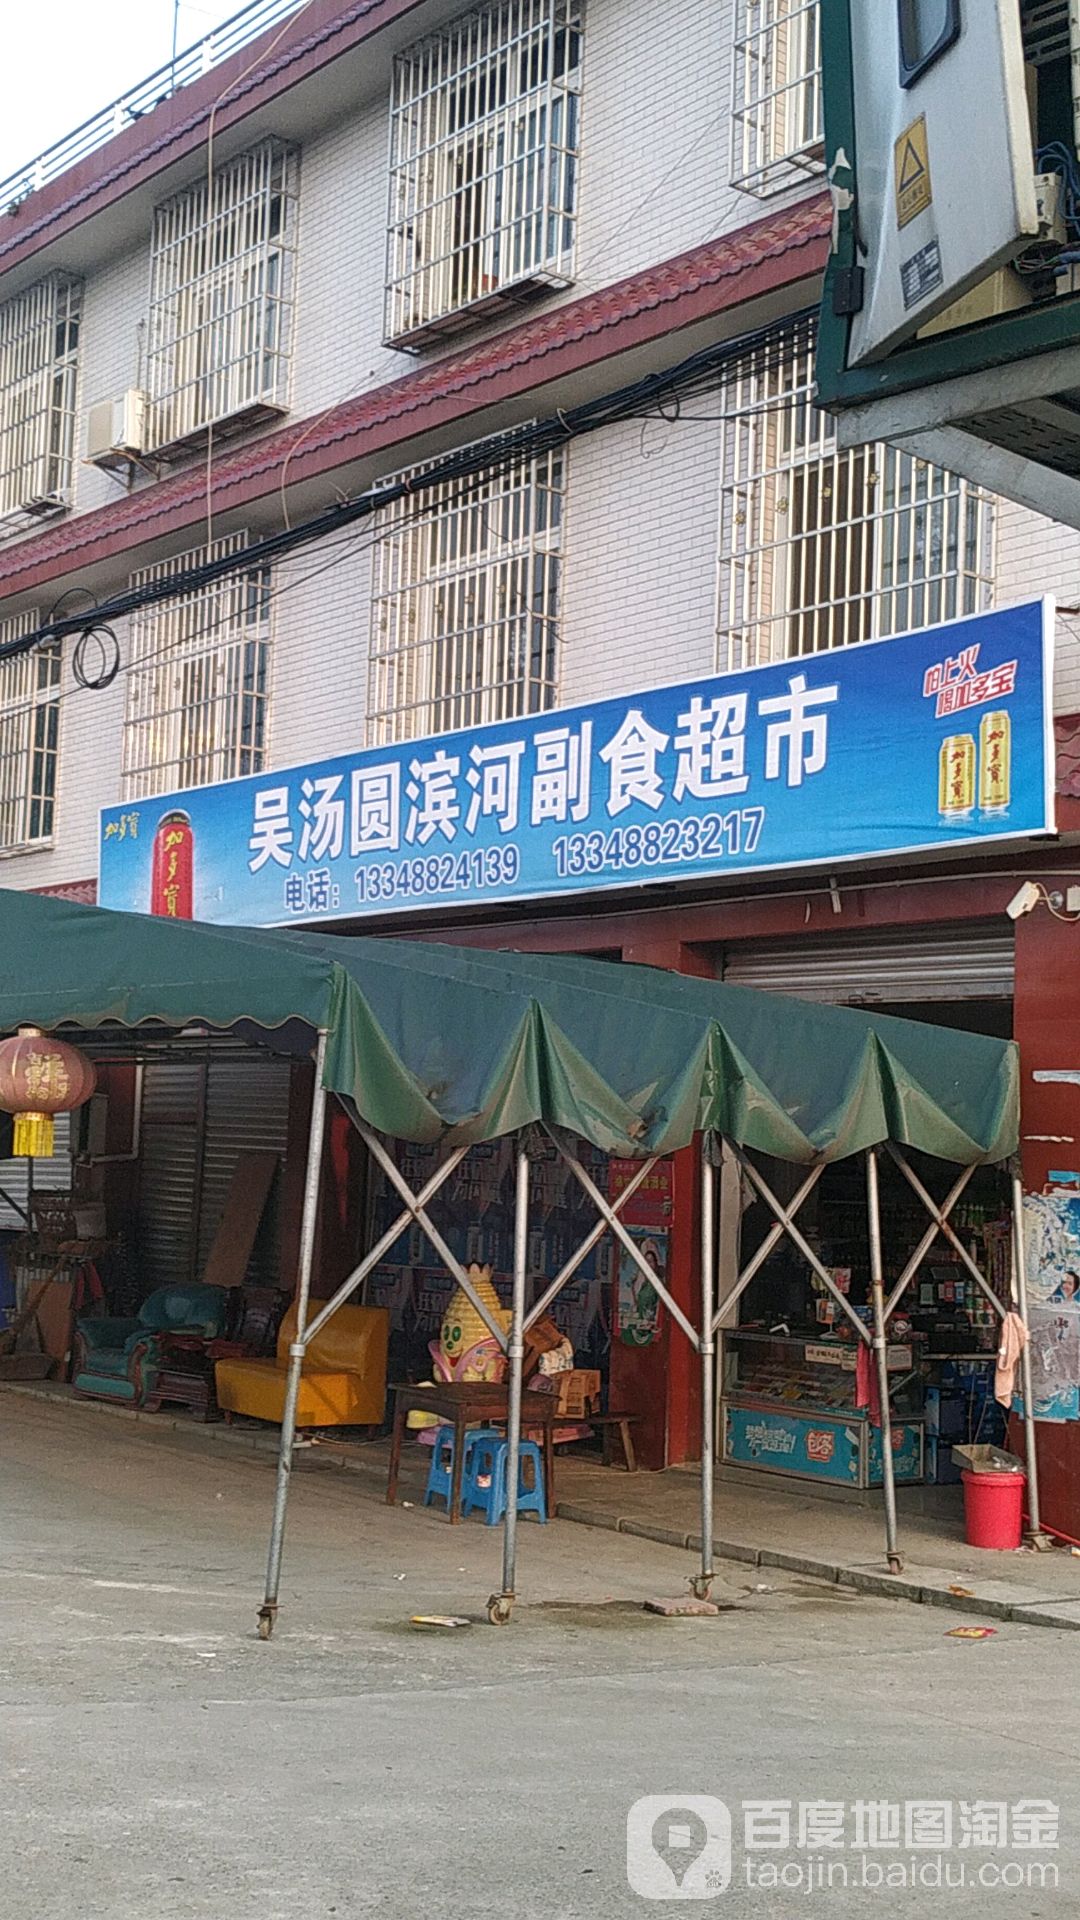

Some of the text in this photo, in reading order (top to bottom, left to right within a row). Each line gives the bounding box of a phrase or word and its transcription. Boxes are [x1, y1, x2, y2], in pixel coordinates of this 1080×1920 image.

[922, 643, 982, 698] 怕上火
[935, 660, 1018, 719] 喝加多宝
[249, 674, 839, 872] 吴汤圆滨河副食超市
[354, 846, 518, 903] 13348824139
[552, 806, 765, 877] 13348823217
